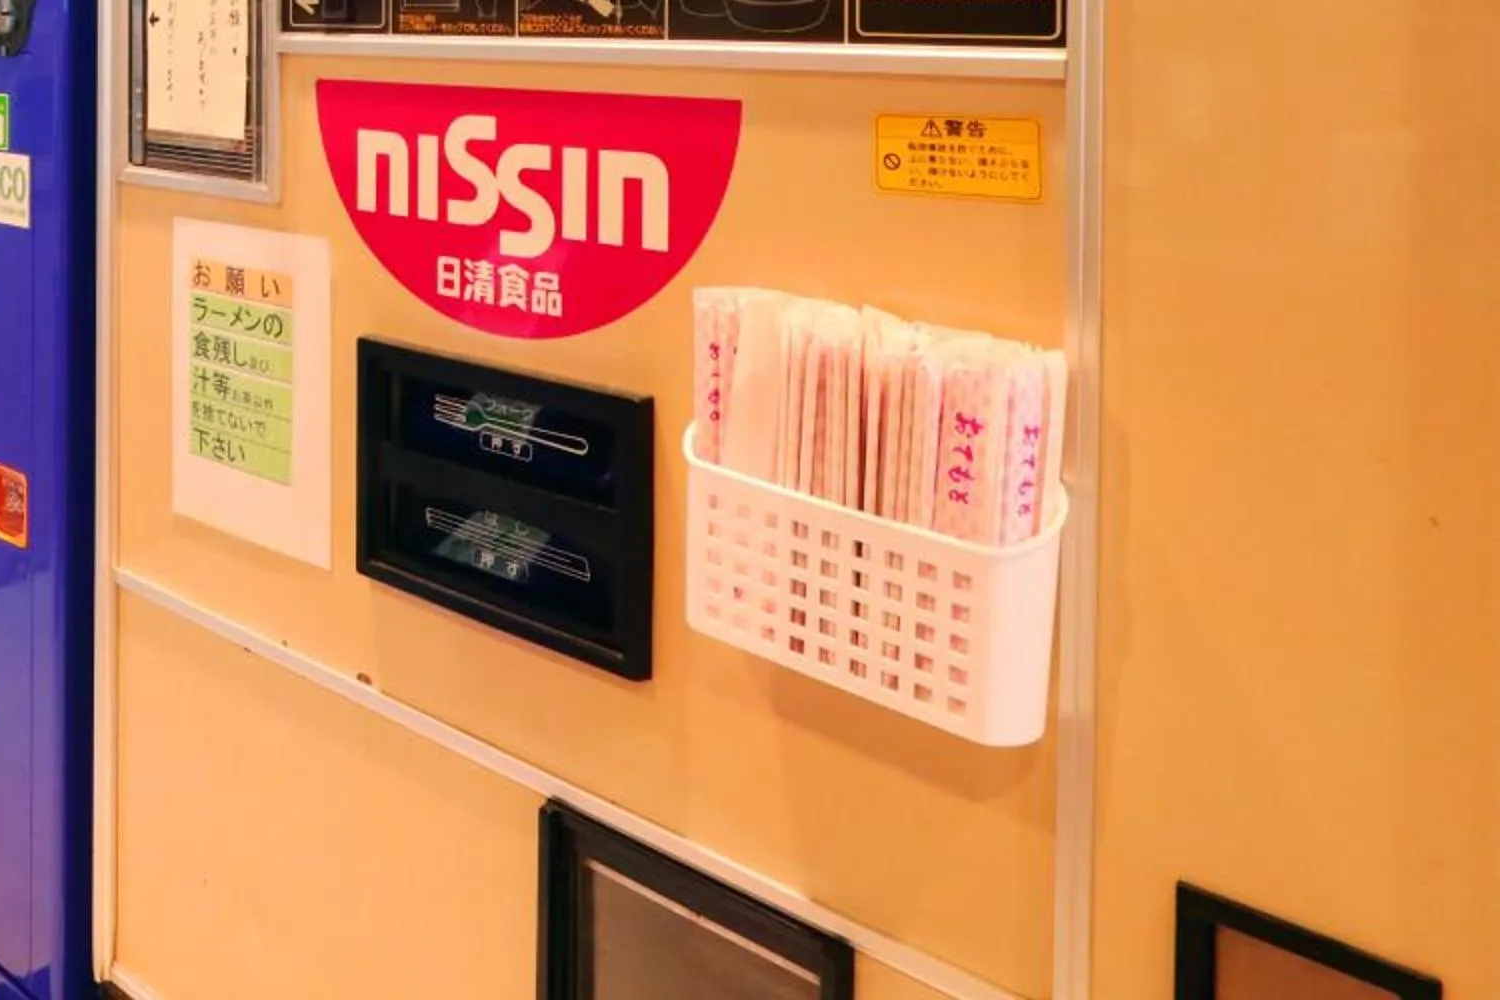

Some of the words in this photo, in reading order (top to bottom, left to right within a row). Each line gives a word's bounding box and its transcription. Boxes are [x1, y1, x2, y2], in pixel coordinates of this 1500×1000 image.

[943, 119, 988, 138] 警告
[192, 261, 280, 299] お願い
[437, 256, 563, 317] 日清食品
[192, 297, 285, 339] ラーメンの
[191, 401, 268, 439] を捨てないで
[484, 397, 535, 423] フォーク
[193, 428, 247, 464] 下さい
[947, 411, 986, 506] おてもと
